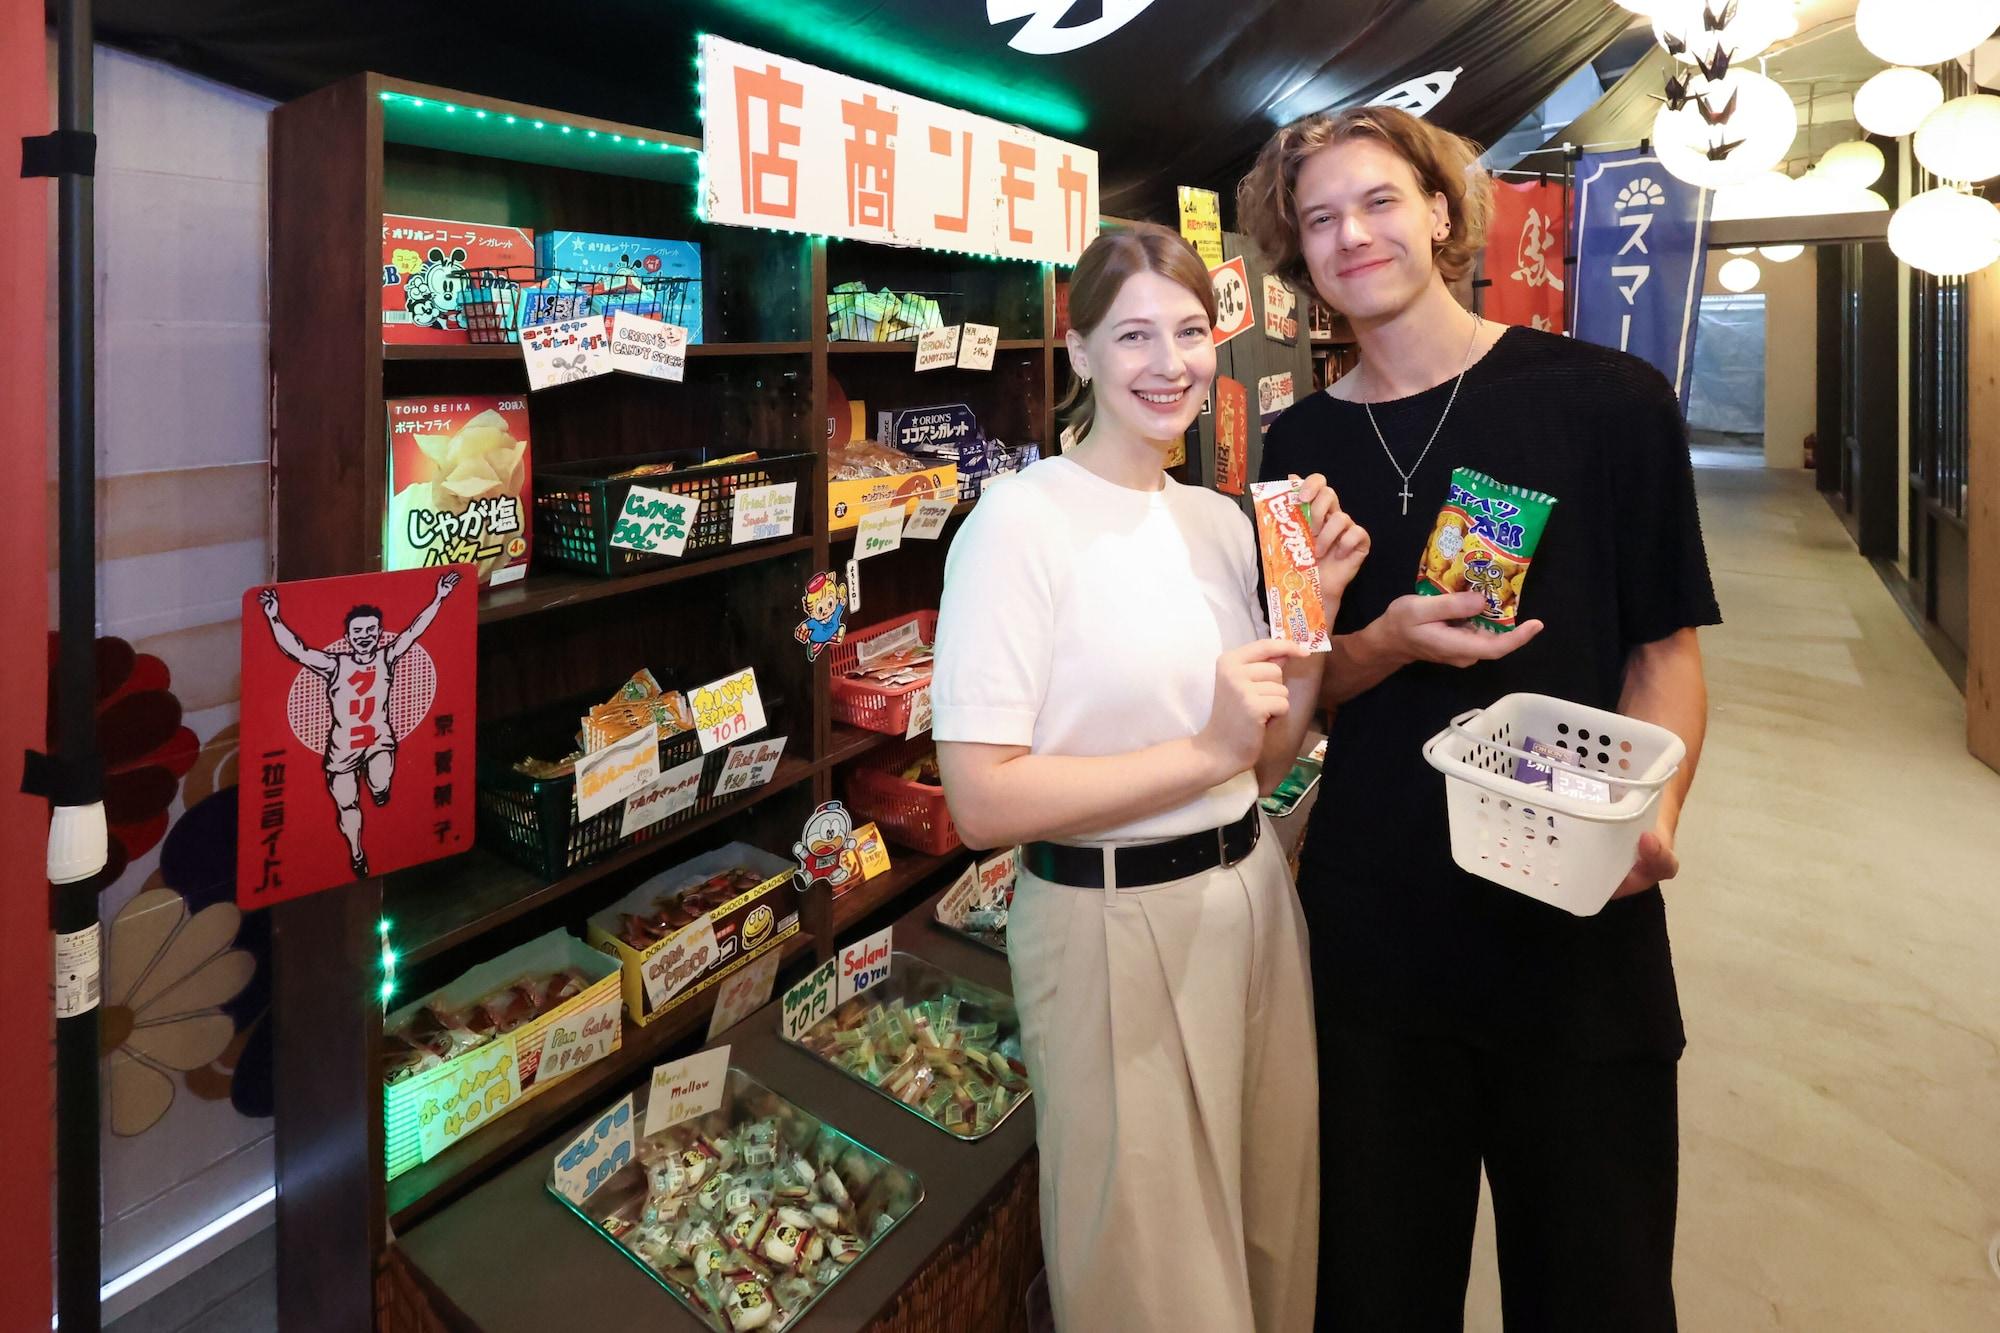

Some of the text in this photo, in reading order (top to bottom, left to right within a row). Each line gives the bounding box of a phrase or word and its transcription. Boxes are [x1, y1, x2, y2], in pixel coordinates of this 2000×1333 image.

[619, 327, 666, 350] ORION'S
[612, 341, 651, 360] CANDY
[396, 404, 471, 415] TOHO SEIKA
[918, 412, 952, 425] ORION'S
[395, 419, 452, 434] ポテトフライ
[901, 420, 969, 445] ココアシガレット
[408, 495, 518, 549] じゃが塩
[1468, 512, 1525, 549] 太郎
[347, 664, 378, 750] グリコ
[844, 939, 888, 976] Salami
[853, 973, 869, 992] 10
[790, 988, 828, 1037] 10円
[552, 1027, 577, 1048] Pan
[670, 1081, 709, 1099] Mallow
